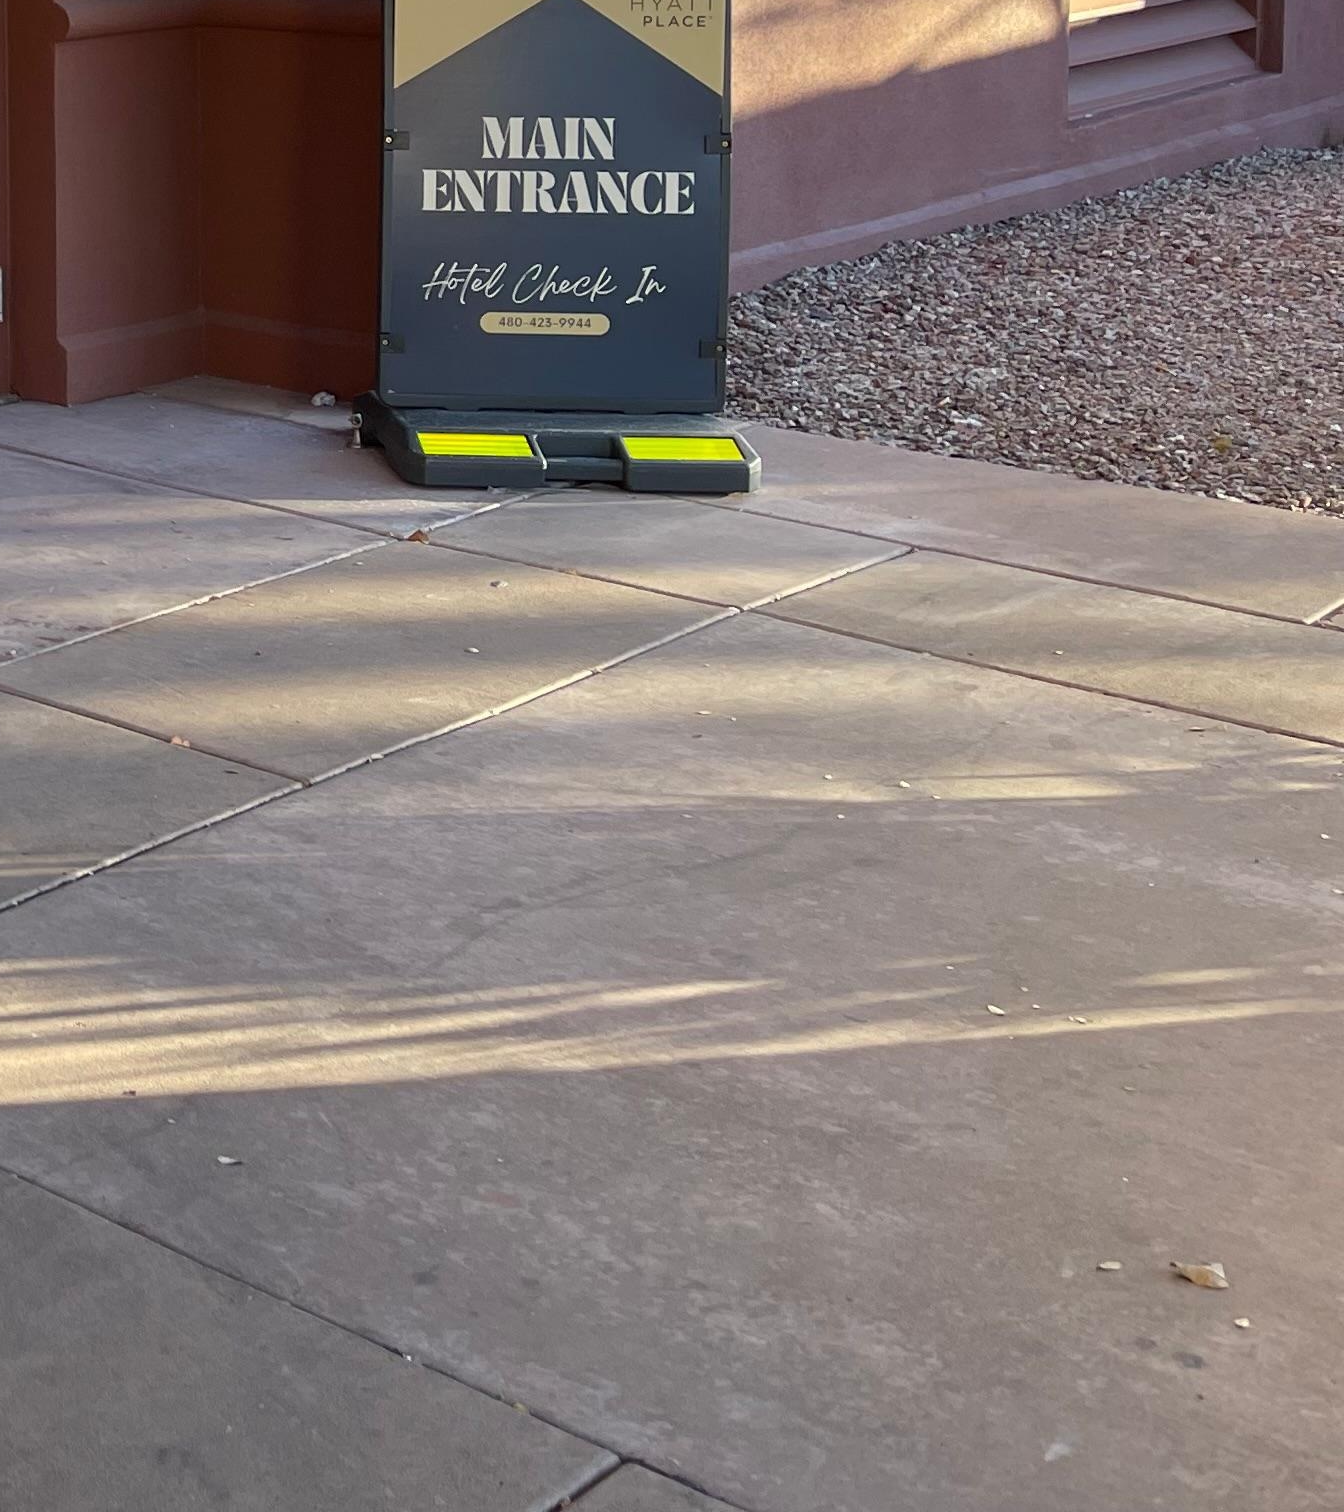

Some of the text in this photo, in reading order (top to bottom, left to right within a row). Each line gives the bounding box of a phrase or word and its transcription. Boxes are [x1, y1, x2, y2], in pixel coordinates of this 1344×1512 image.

[642, 15, 707, 28] PLACE
[480, 116, 616, 161] MAIN
[421, 168, 695, 215] ENTRANCE
[422, 261, 666, 306] Hotel Check In
[498, 316, 593, 330] 480-423-9944
